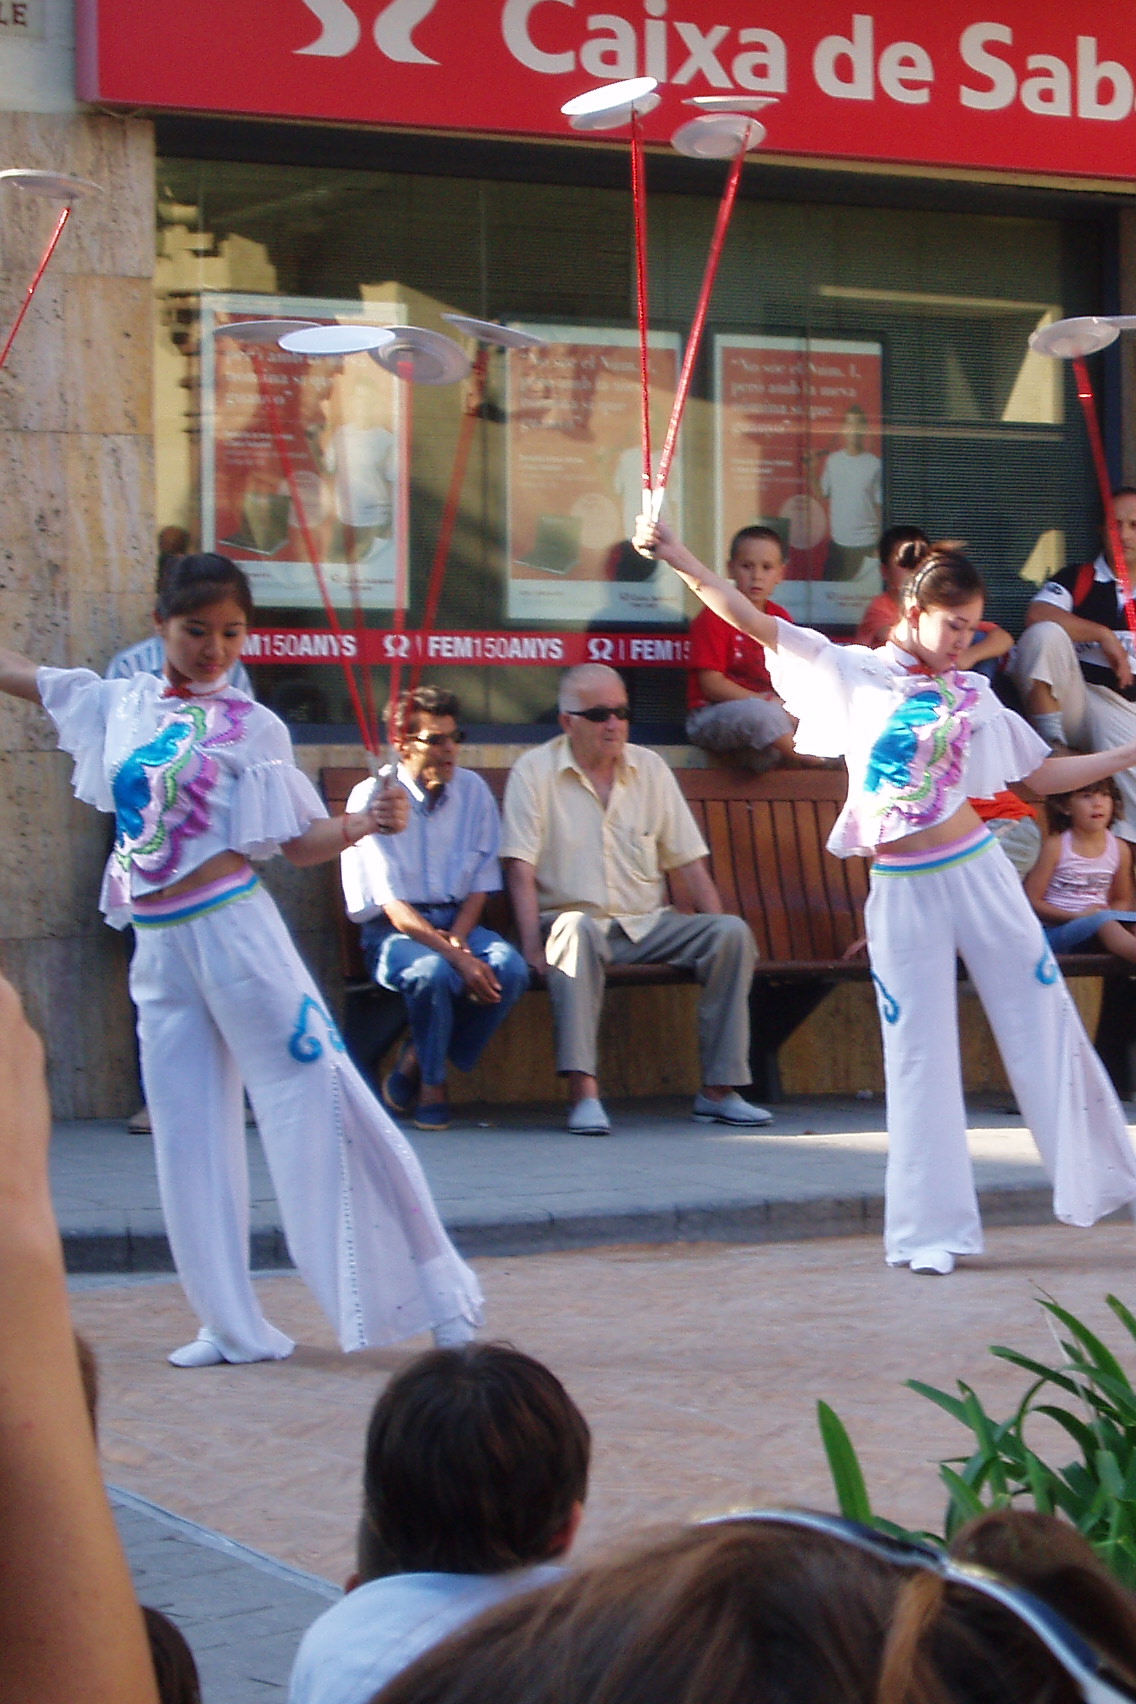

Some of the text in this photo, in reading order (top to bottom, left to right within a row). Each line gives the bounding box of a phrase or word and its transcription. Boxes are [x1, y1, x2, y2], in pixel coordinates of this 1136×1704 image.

[502, 0, 788, 94] Caixa
[813, 14, 935, 104] de
[427, 635, 565, 660] FEM150ANYS
